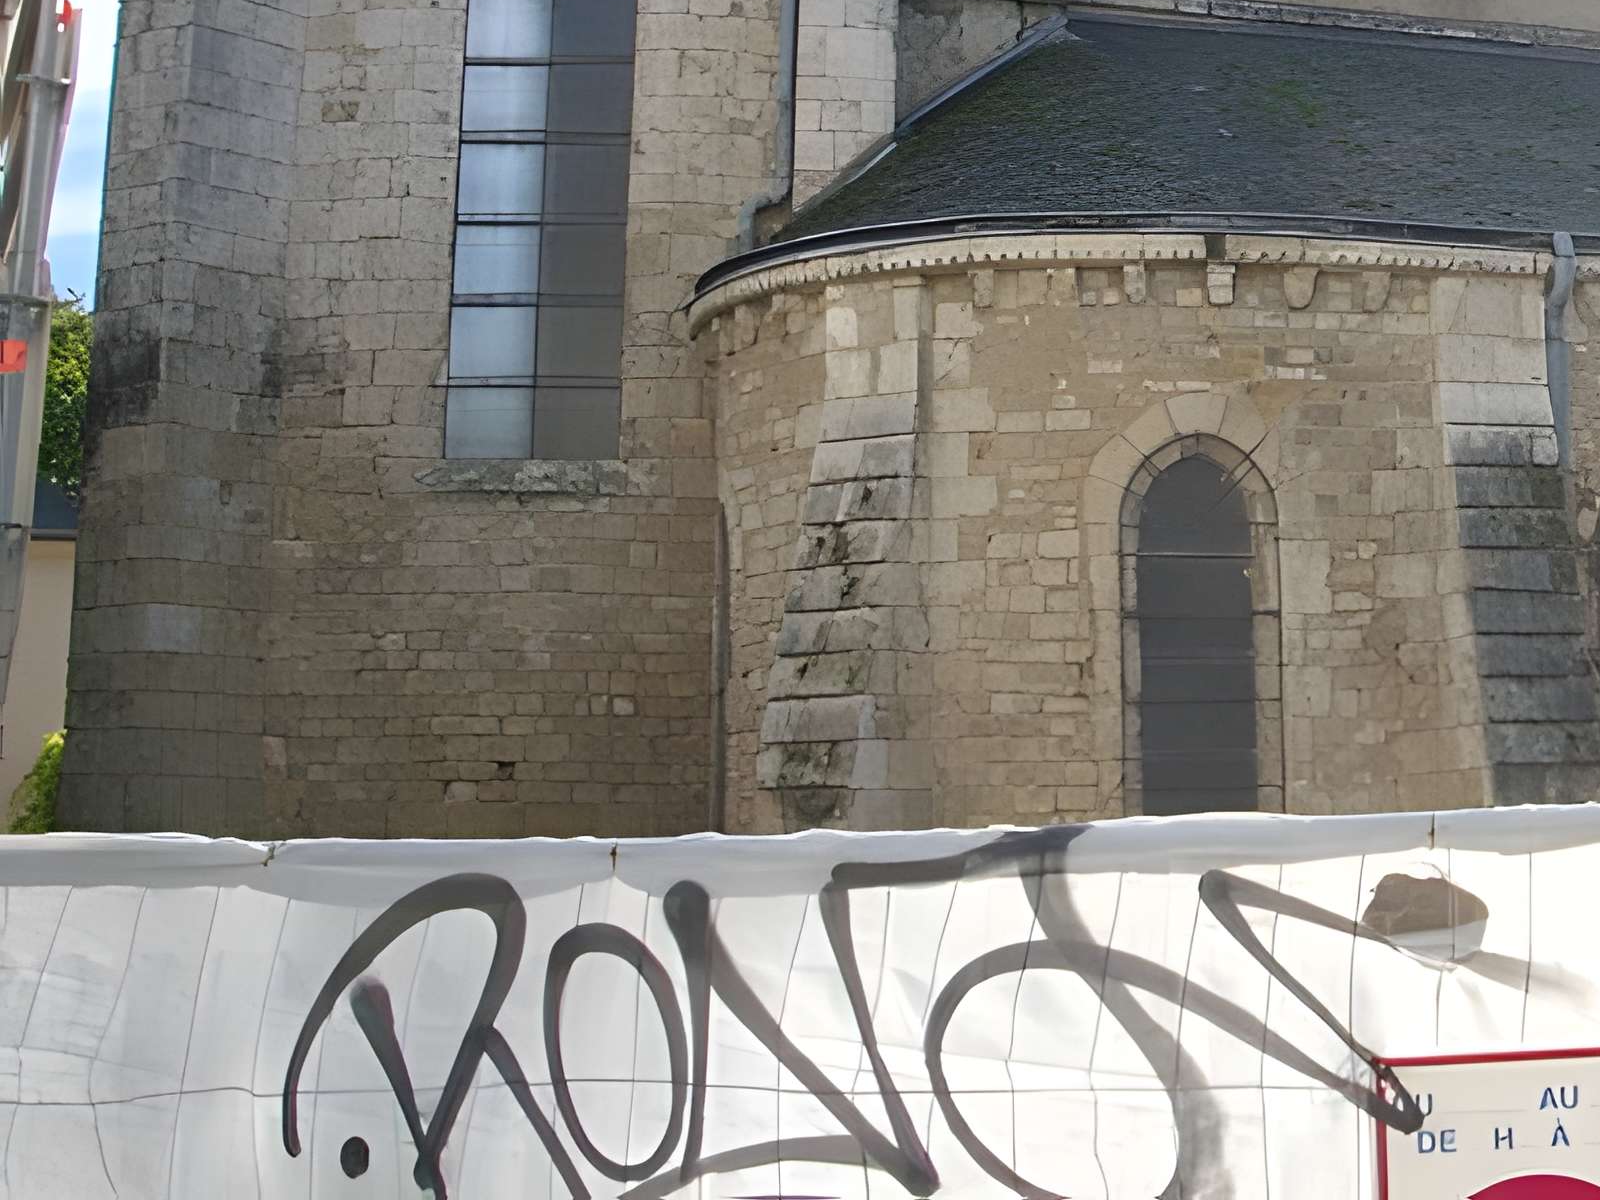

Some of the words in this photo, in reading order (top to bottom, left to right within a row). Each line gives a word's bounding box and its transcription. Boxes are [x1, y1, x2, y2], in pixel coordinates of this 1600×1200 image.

[1539, 1085, 1578, 1110] AU
[1417, 1129, 1457, 1154] DE
[1495, 1127, 1513, 1149] H
